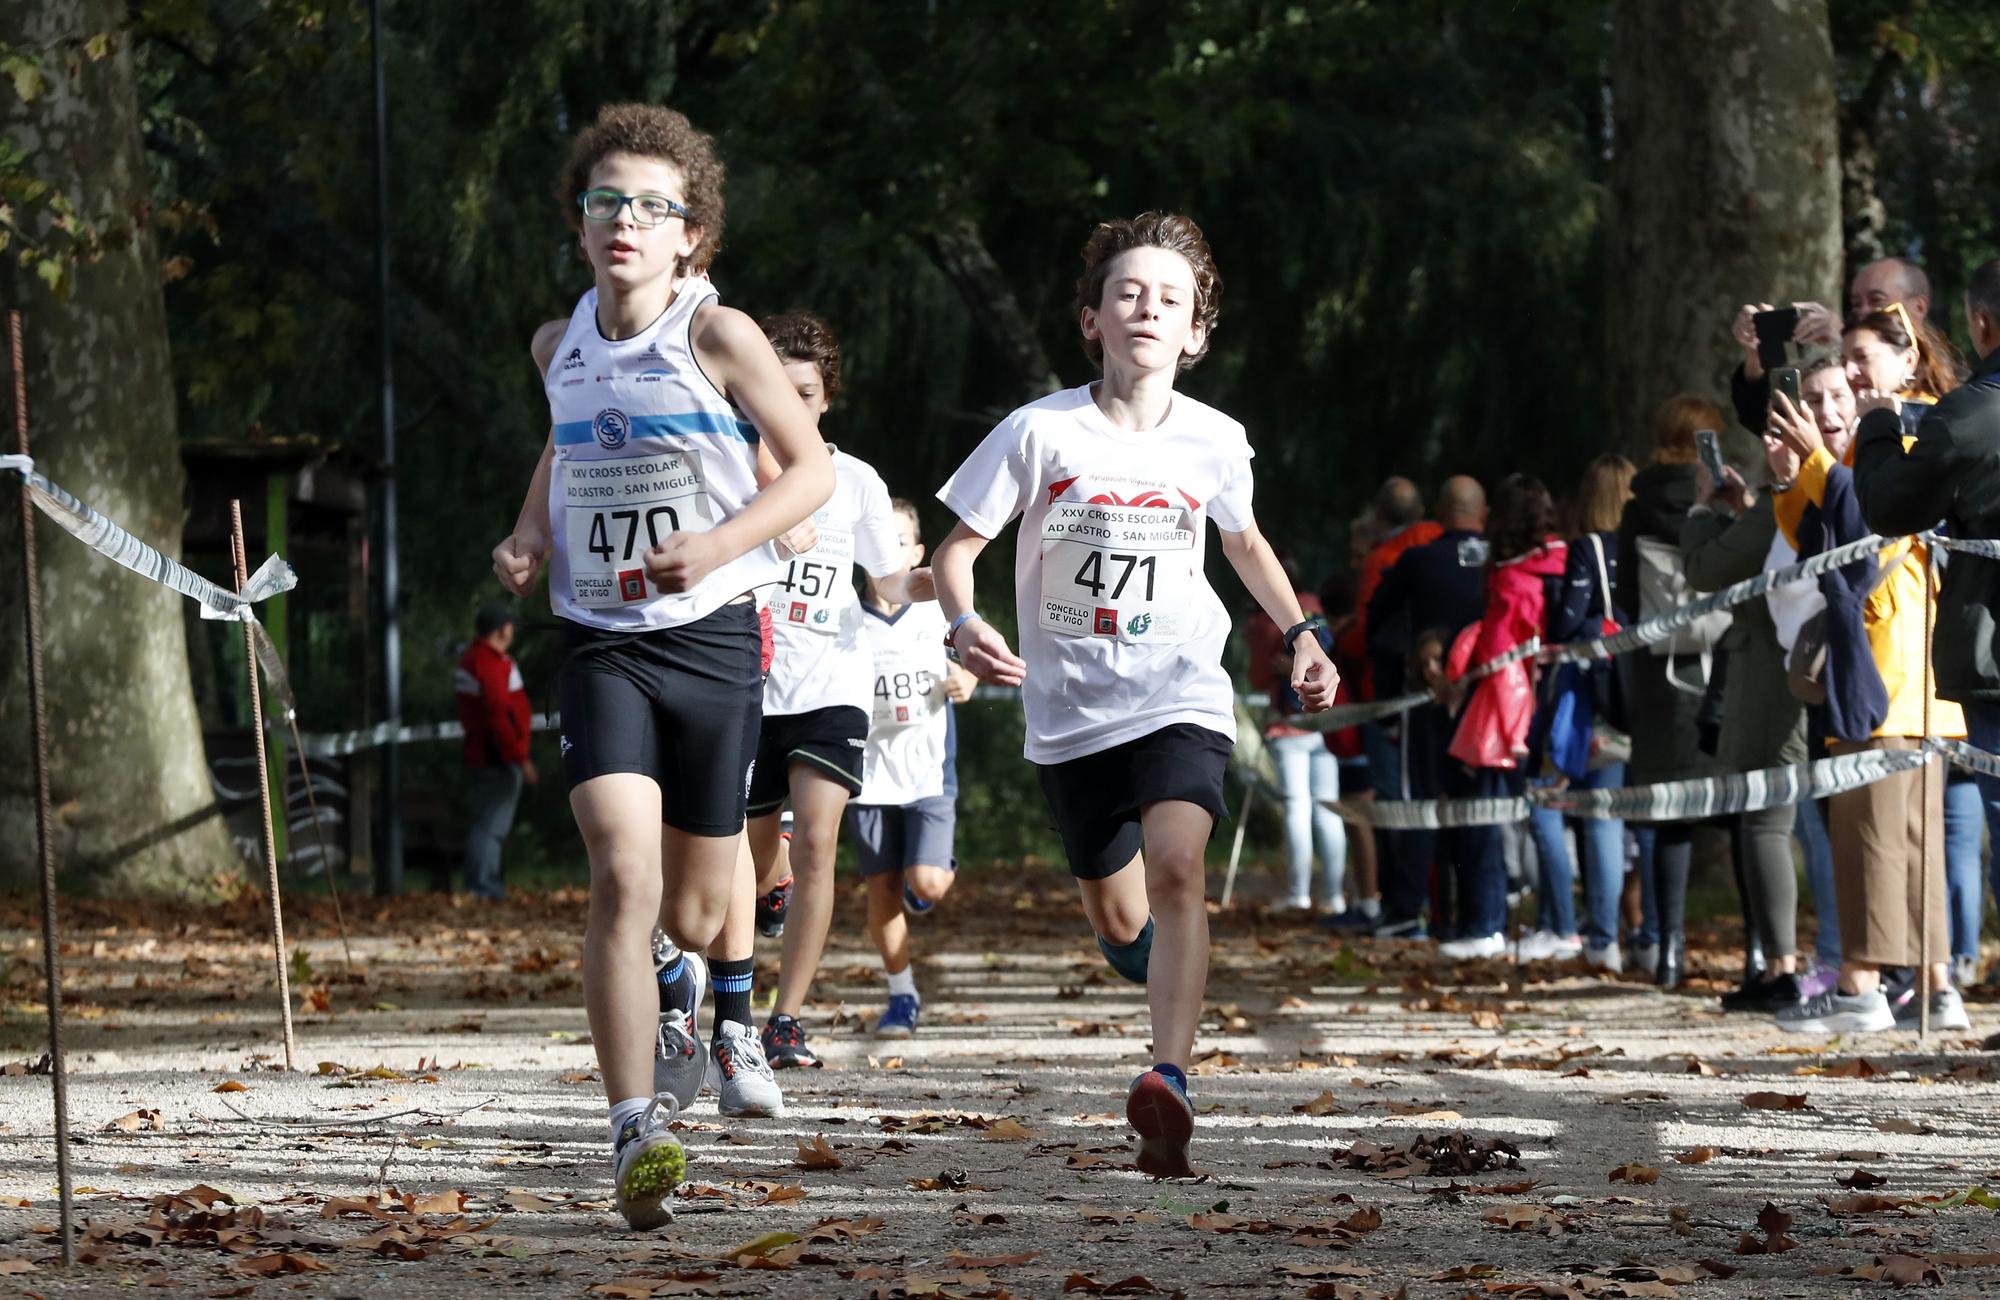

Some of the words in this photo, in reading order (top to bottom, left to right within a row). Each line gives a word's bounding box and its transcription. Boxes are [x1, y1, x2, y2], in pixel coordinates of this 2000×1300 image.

[572, 468, 587, 479] XXV
[589, 466, 623, 479] CROSS
[625, 459, 680, 476] ESCOLAR
[567, 486, 577, 497] AD
[578, 486, 614, 498] CASTRO
[625, 483, 650, 495] SAN
[653, 474, 701, 492] MIGUEL
[1061, 508, 1085, 518] XXV
[1088, 509, 1124, 523] CROSS
[1128, 514, 1176, 524] ESCOLAR
[588, 505, 680, 563] 470
[1047, 524, 1065, 532] AD
[1068, 524, 1111, 539] CASTRO
[1123, 531, 1146, 541] SAN
[1149, 531, 1189, 541] MIGUEL
[574, 578, 613, 588] CONCELLO
[778, 560, 838, 599] 457
[1074, 550, 1156, 602] 471
[579, 588, 588, 598] DE
[590, 589, 609, 598] VIGO
[769, 600, 786, 609] ELLO
[1046, 602, 1089, 618] CONCELLO
[1049, 612, 1062, 622] DE
[1063, 614, 1083, 626] VIGO
[874, 669, 932, 701] 485
